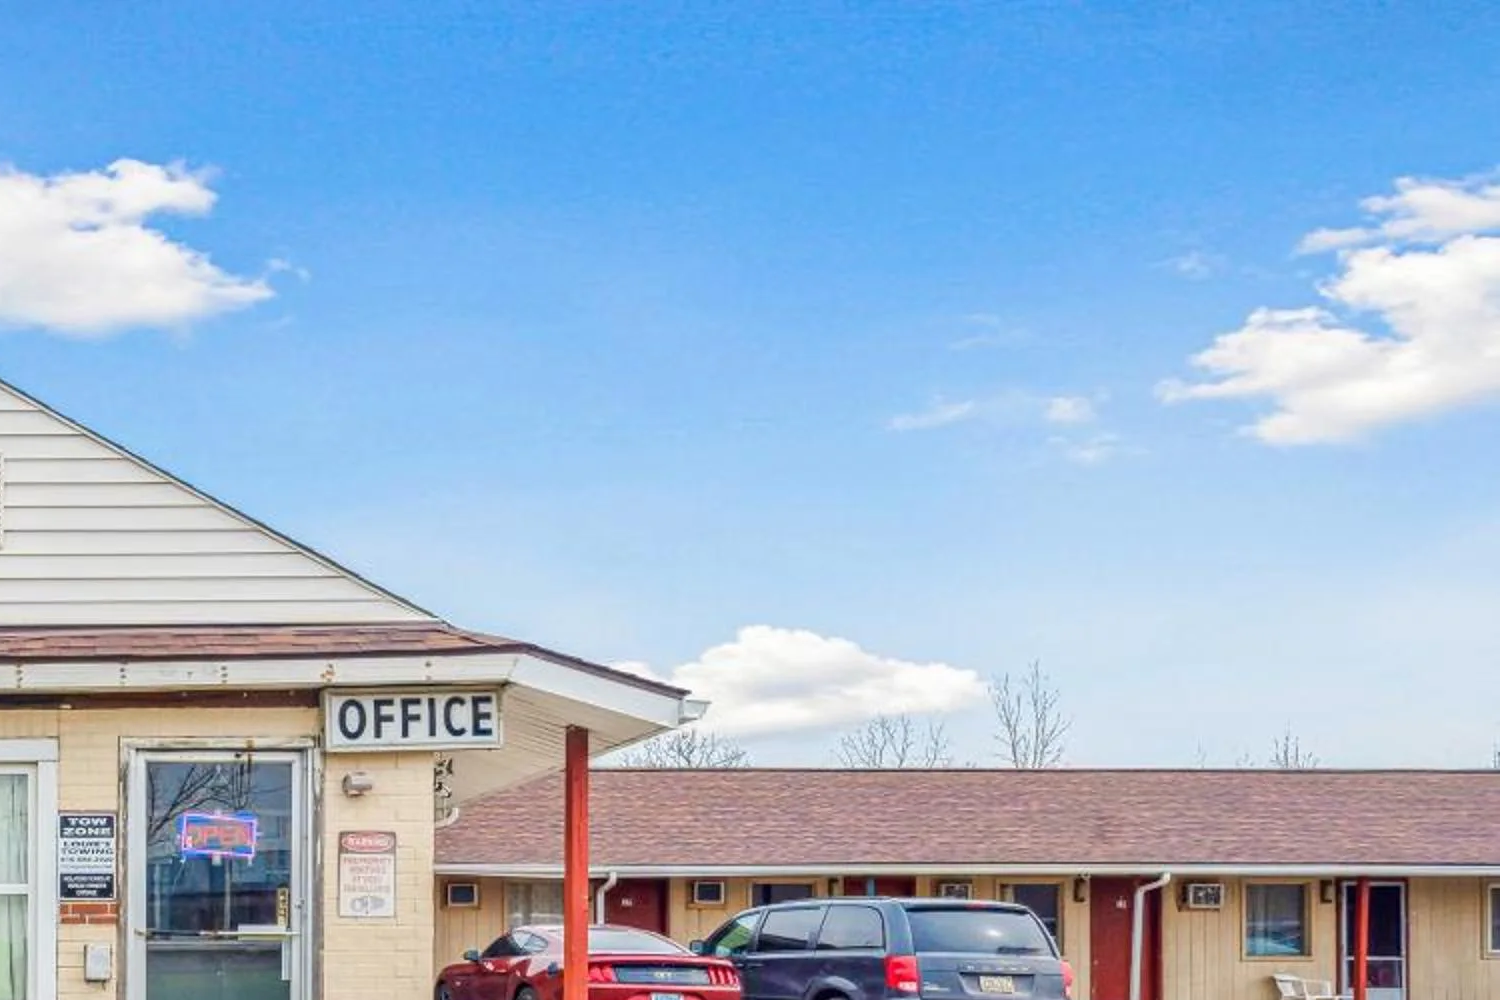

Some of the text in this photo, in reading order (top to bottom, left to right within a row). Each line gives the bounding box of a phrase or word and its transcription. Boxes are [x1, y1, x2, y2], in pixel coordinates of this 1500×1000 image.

[338, 695, 493, 740] OFFICE
[67, 817, 108, 827] TOW
[62, 827, 112, 837] ZONE
[61, 847, 115, 856] TOWING
